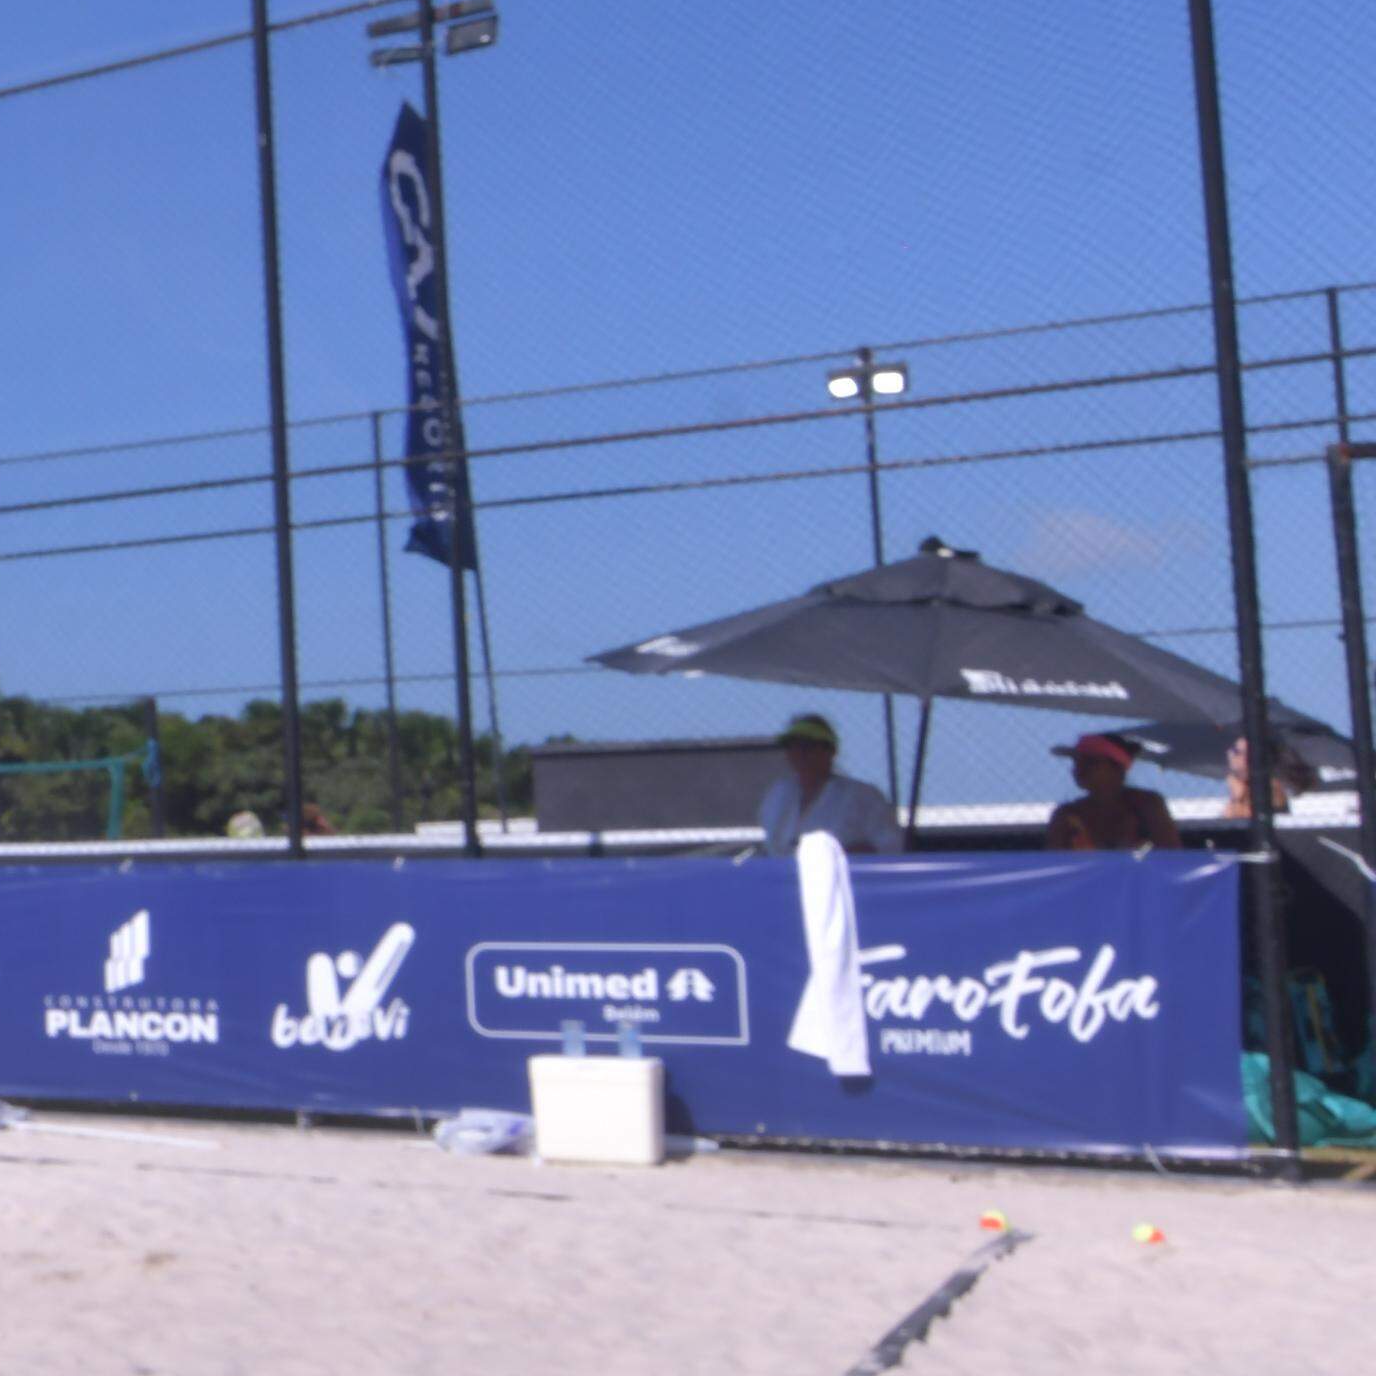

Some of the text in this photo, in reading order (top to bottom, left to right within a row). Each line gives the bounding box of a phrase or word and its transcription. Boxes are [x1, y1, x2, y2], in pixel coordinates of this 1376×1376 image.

[495, 965, 658, 1000] Unimed
[859, 944, 1159, 1042] aroFofa
[44, 994, 219, 1011] CONSTRUTORA
[45, 1009, 219, 1043] PLANCON
[880, 1028, 971, 1056] PREMIUM
